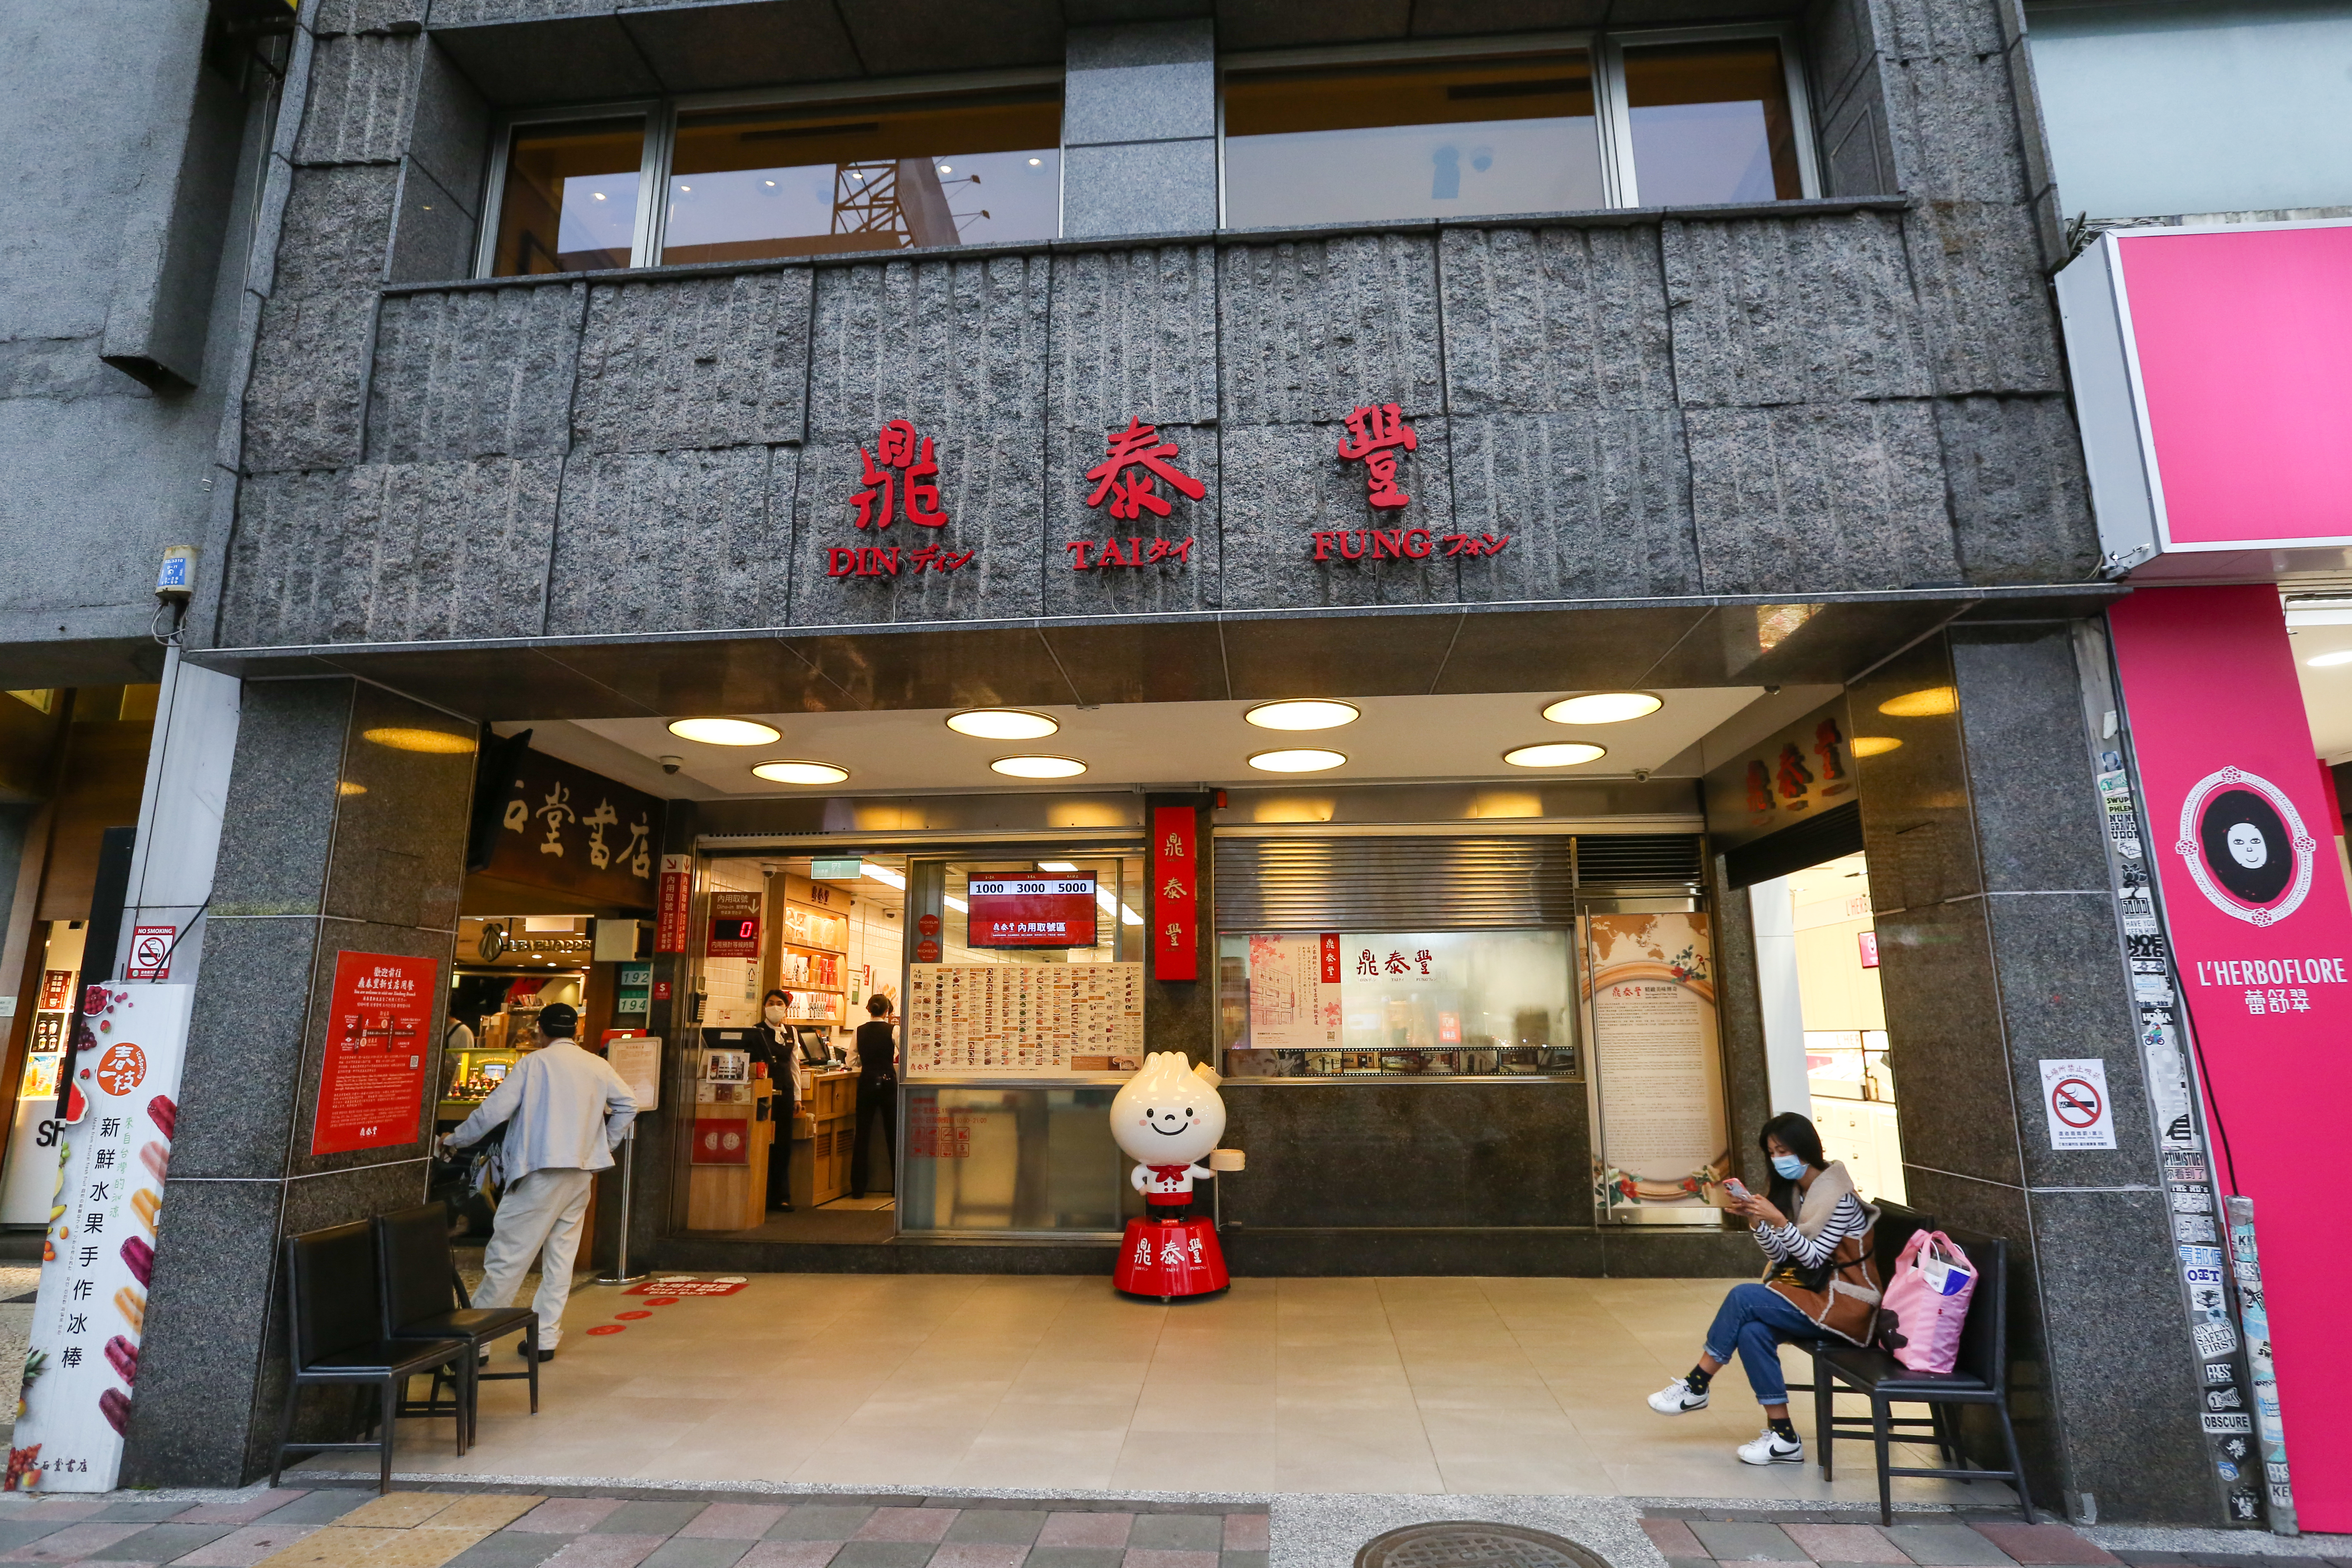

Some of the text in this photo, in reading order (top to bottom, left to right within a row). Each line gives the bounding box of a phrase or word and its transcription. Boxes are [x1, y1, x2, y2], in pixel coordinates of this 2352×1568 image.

[1067, 536, 1194, 571] TAI タイ
[1311, 528, 1510, 561] FUNG フォン
[827, 546, 974, 577] DIN ディン
[976, 884, 1004, 893] 1000
[1017, 883, 1045, 893] 3000
[1058, 883, 1087, 892] 5000
[1163, 832, 1187, 946] 鼎泰豐
[1326, 938, 1336, 976] 鼎泰豐
[2129, 945, 2164, 957] 246
[1356, 949, 1432, 976] 鼎泰豐
[2196, 958, 2347, 986] L'HERBOFLORE
[624, 973, 649, 983] 192
[621, 1000, 646, 1010] 194
[2245, 989, 2311, 1014] 蕾舒翠
[62, 1117, 121, 1369] 新鮮水果手作冰棒
[1134, 1238, 1203, 1266] 鼎泰豐
[2194, 1319, 2231, 1336] AIN'T NO
[2196, 1328, 2233, 1346] SAFETY
[2202, 1338, 2235, 1354] FIRST
[2205, 1415, 2248, 1428] OBSCURE
